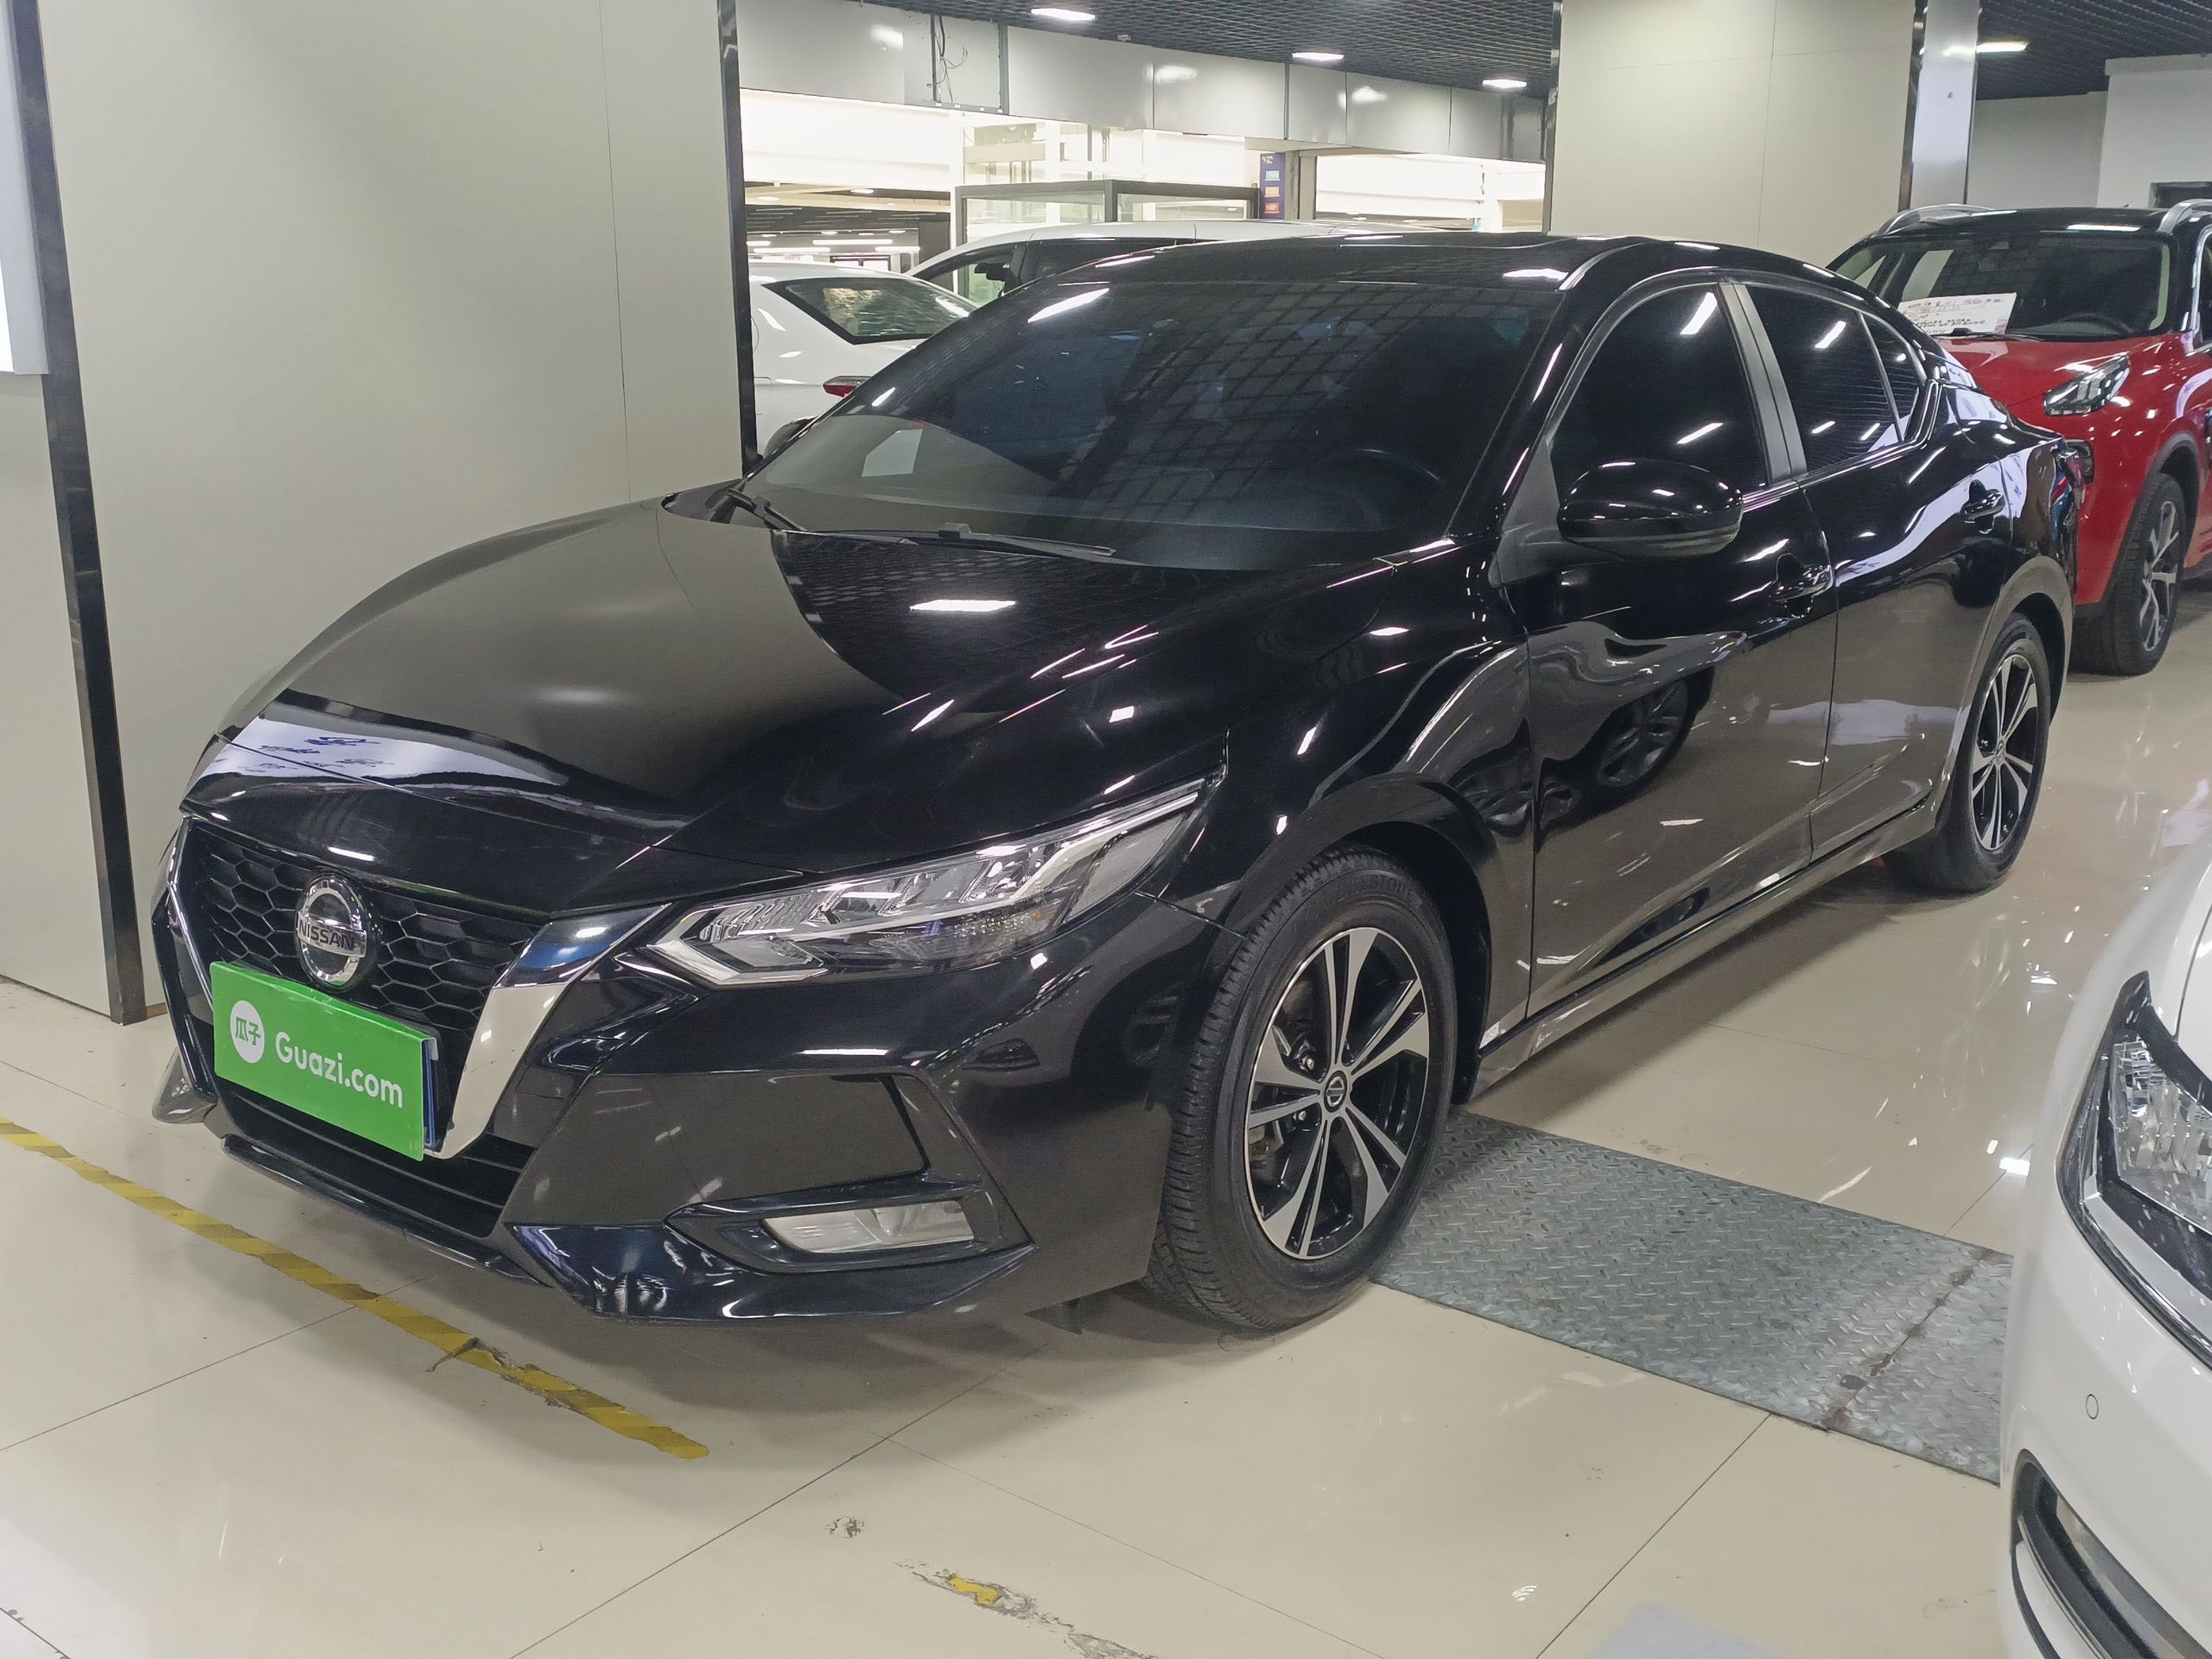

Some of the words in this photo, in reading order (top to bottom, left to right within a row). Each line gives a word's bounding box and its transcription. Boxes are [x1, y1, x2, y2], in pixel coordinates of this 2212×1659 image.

[299, 921, 354, 950] NISSAN
[235, 1016, 261, 1046] 瓜子
[275, 1032, 403, 1109] Guazi.com
